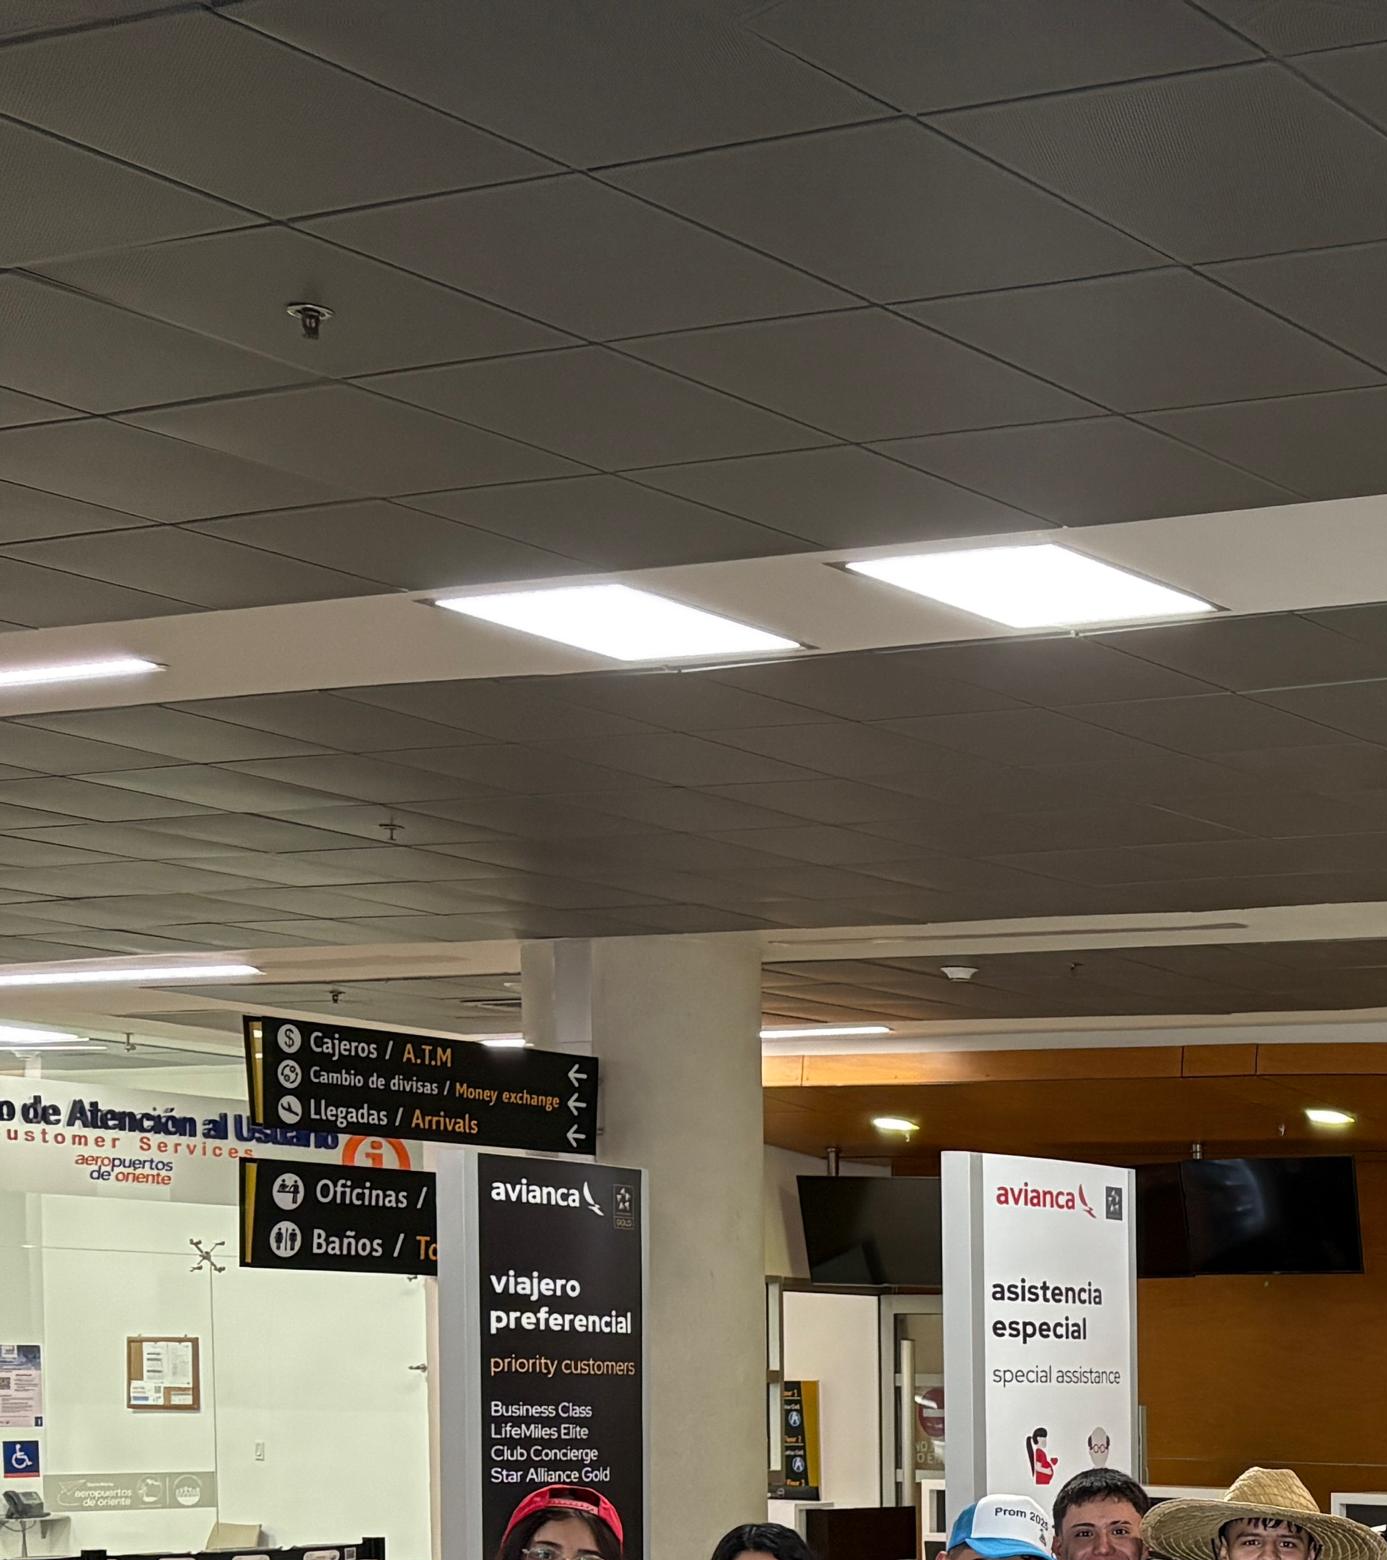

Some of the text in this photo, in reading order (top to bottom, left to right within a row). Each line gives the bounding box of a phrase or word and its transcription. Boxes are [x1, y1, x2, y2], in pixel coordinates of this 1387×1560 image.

[310, 1032, 453, 1068] Cajeros A.T.M
[310, 1066, 561, 1112] Cambio de divisas Money exchange
[21, 1095, 61, 1126] de
[66, 1098, 197, 1138] Atención
[202, 1113, 229, 1140] al
[310, 1100, 479, 1134] Llegadas Arrivals
[74, 1153, 174, 1173] aeropuertos
[90, 1166, 172, 1186] de oriente
[315, 1178, 408, 1209] Oficinas
[490, 1178, 580, 1207] avianca
[996, 1182, 1075, 1210] avianca
[311, 1228, 383, 1259] Baños
[490, 1270, 581, 1301] viajero
[991, 1278, 1103, 1305] asistencia
[490, 1307, 632, 1334] preferencial
[992, 1316, 1087, 1344] especial
[490, 1354, 636, 1377] priority customers
[992, 1365, 1121, 1388] special assistance
[490, 1401, 592, 1418] Business Class
[490, 1423, 589, 1439] LifeMiles Elite
[490, 1446, 598, 1463] Club Concierge
[490, 1466, 610, 1483] Star Alliance Gold
[995, 1507, 1027, 1518] Prom
